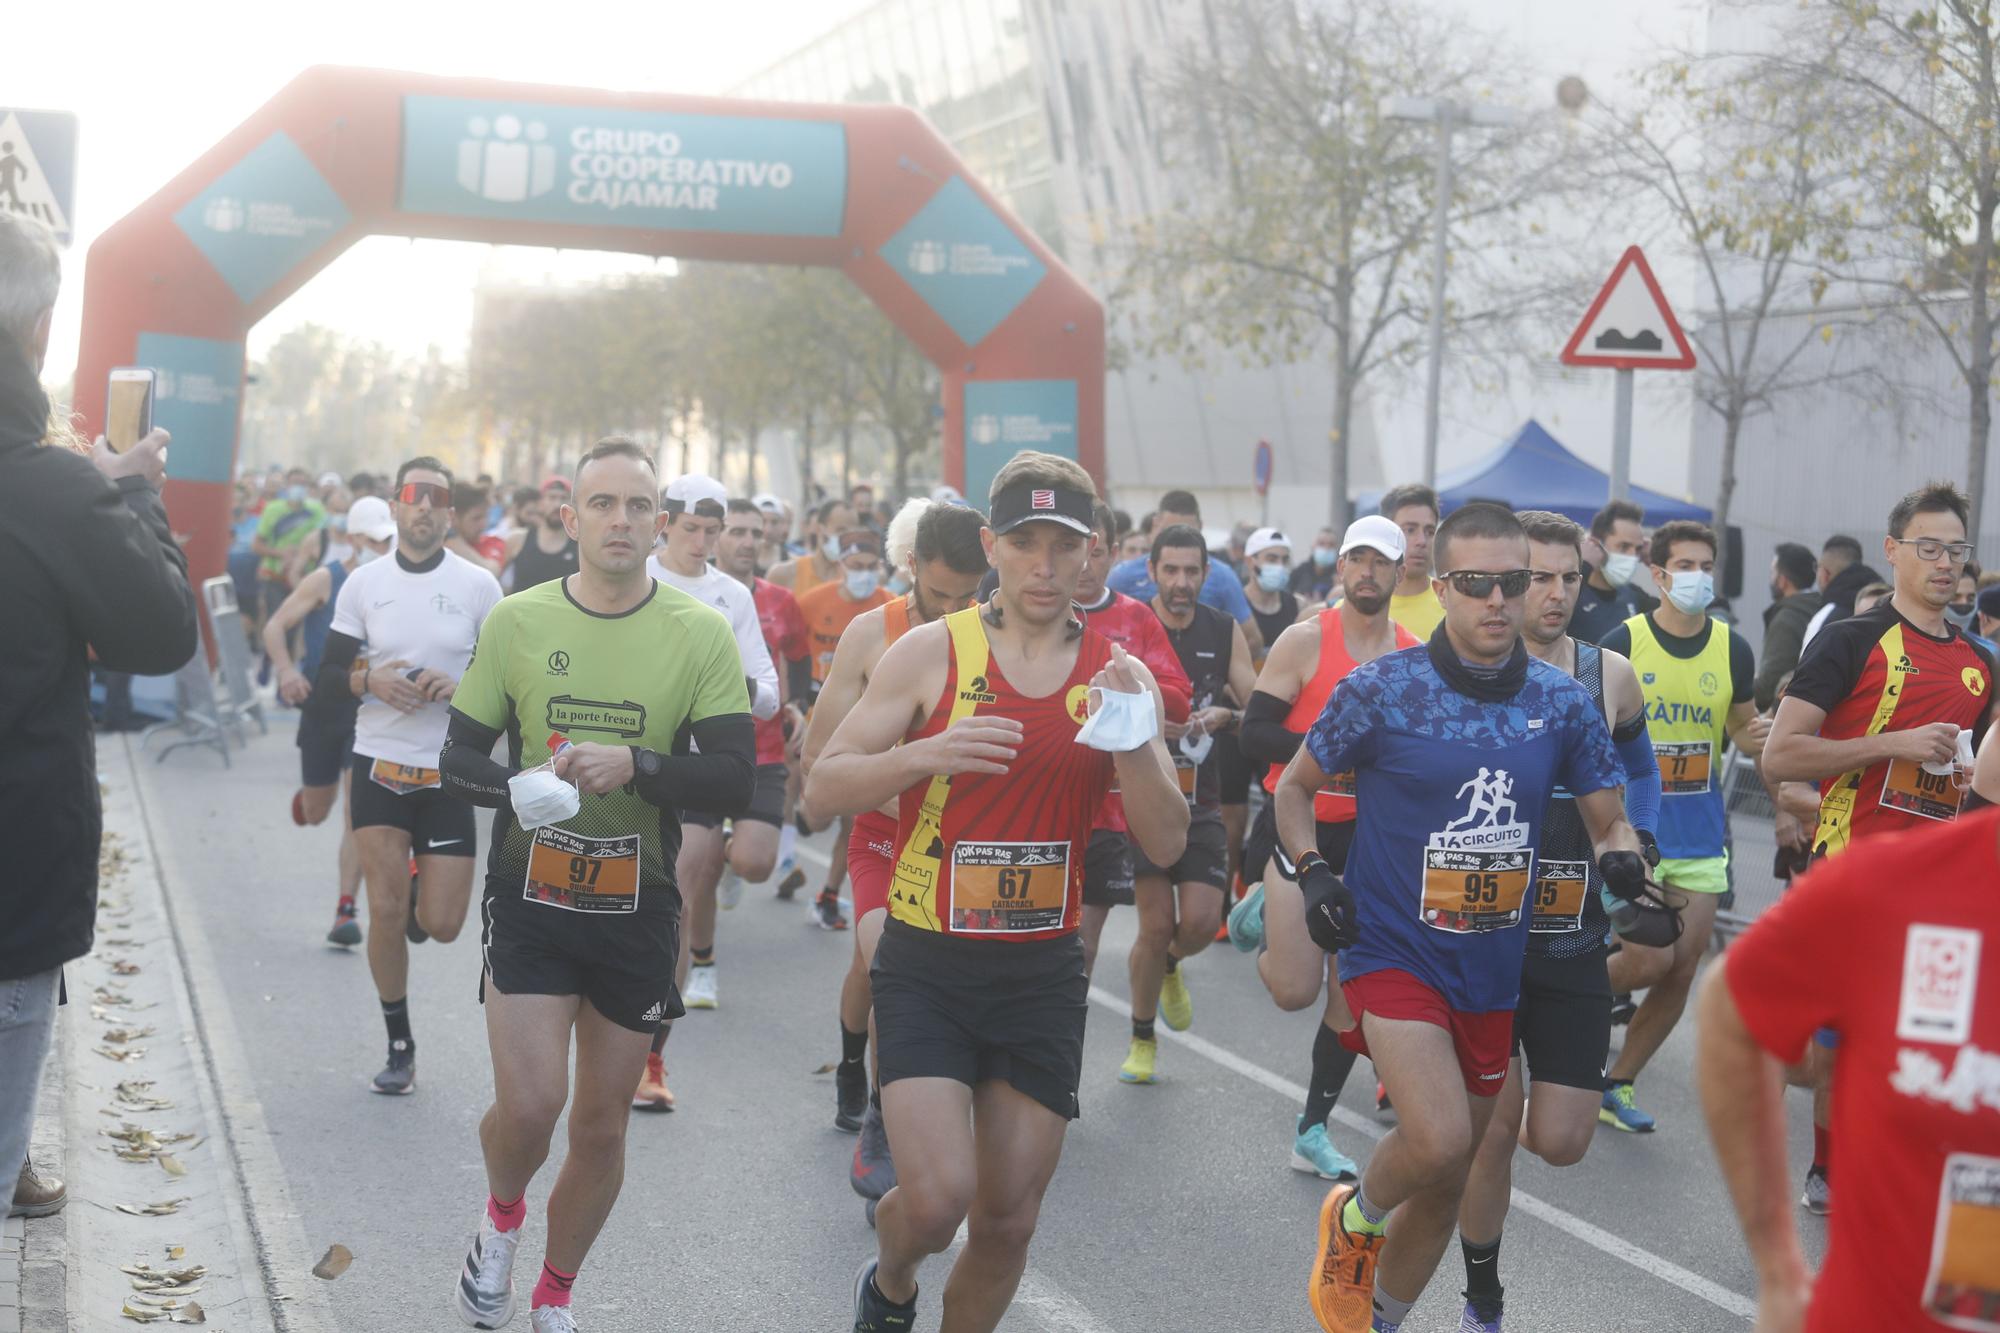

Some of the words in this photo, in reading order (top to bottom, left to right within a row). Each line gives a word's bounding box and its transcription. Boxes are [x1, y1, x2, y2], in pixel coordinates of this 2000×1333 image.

[570, 127, 681, 156] GRUPO
[569, 153, 792, 188] COOPERATIVO
[568, 180, 719, 211] CAJAMAR
[960, 691, 996, 703] VIATOR
[556, 709, 567, 719] la
[570, 712, 600, 722] porte
[603, 713, 636, 725] fresca
[1672, 758, 1687, 775] 77
[539, 829, 554, 839] 10K
[554, 834, 569, 844] PAS
[569, 839, 585, 850] RAS
[1462, 828, 1522, 846] CIRCUITO
[957, 845, 976, 858] 10K
[975, 847, 993, 856] PAS
[994, 848, 1012, 859] RAS
[1446, 853, 1463, 861] PAS
[1465, 855, 1481, 865] RAS
[569, 856, 602, 885] 97
[998, 867, 1032, 900] 67
[1464, 873, 1498, 903] 95
